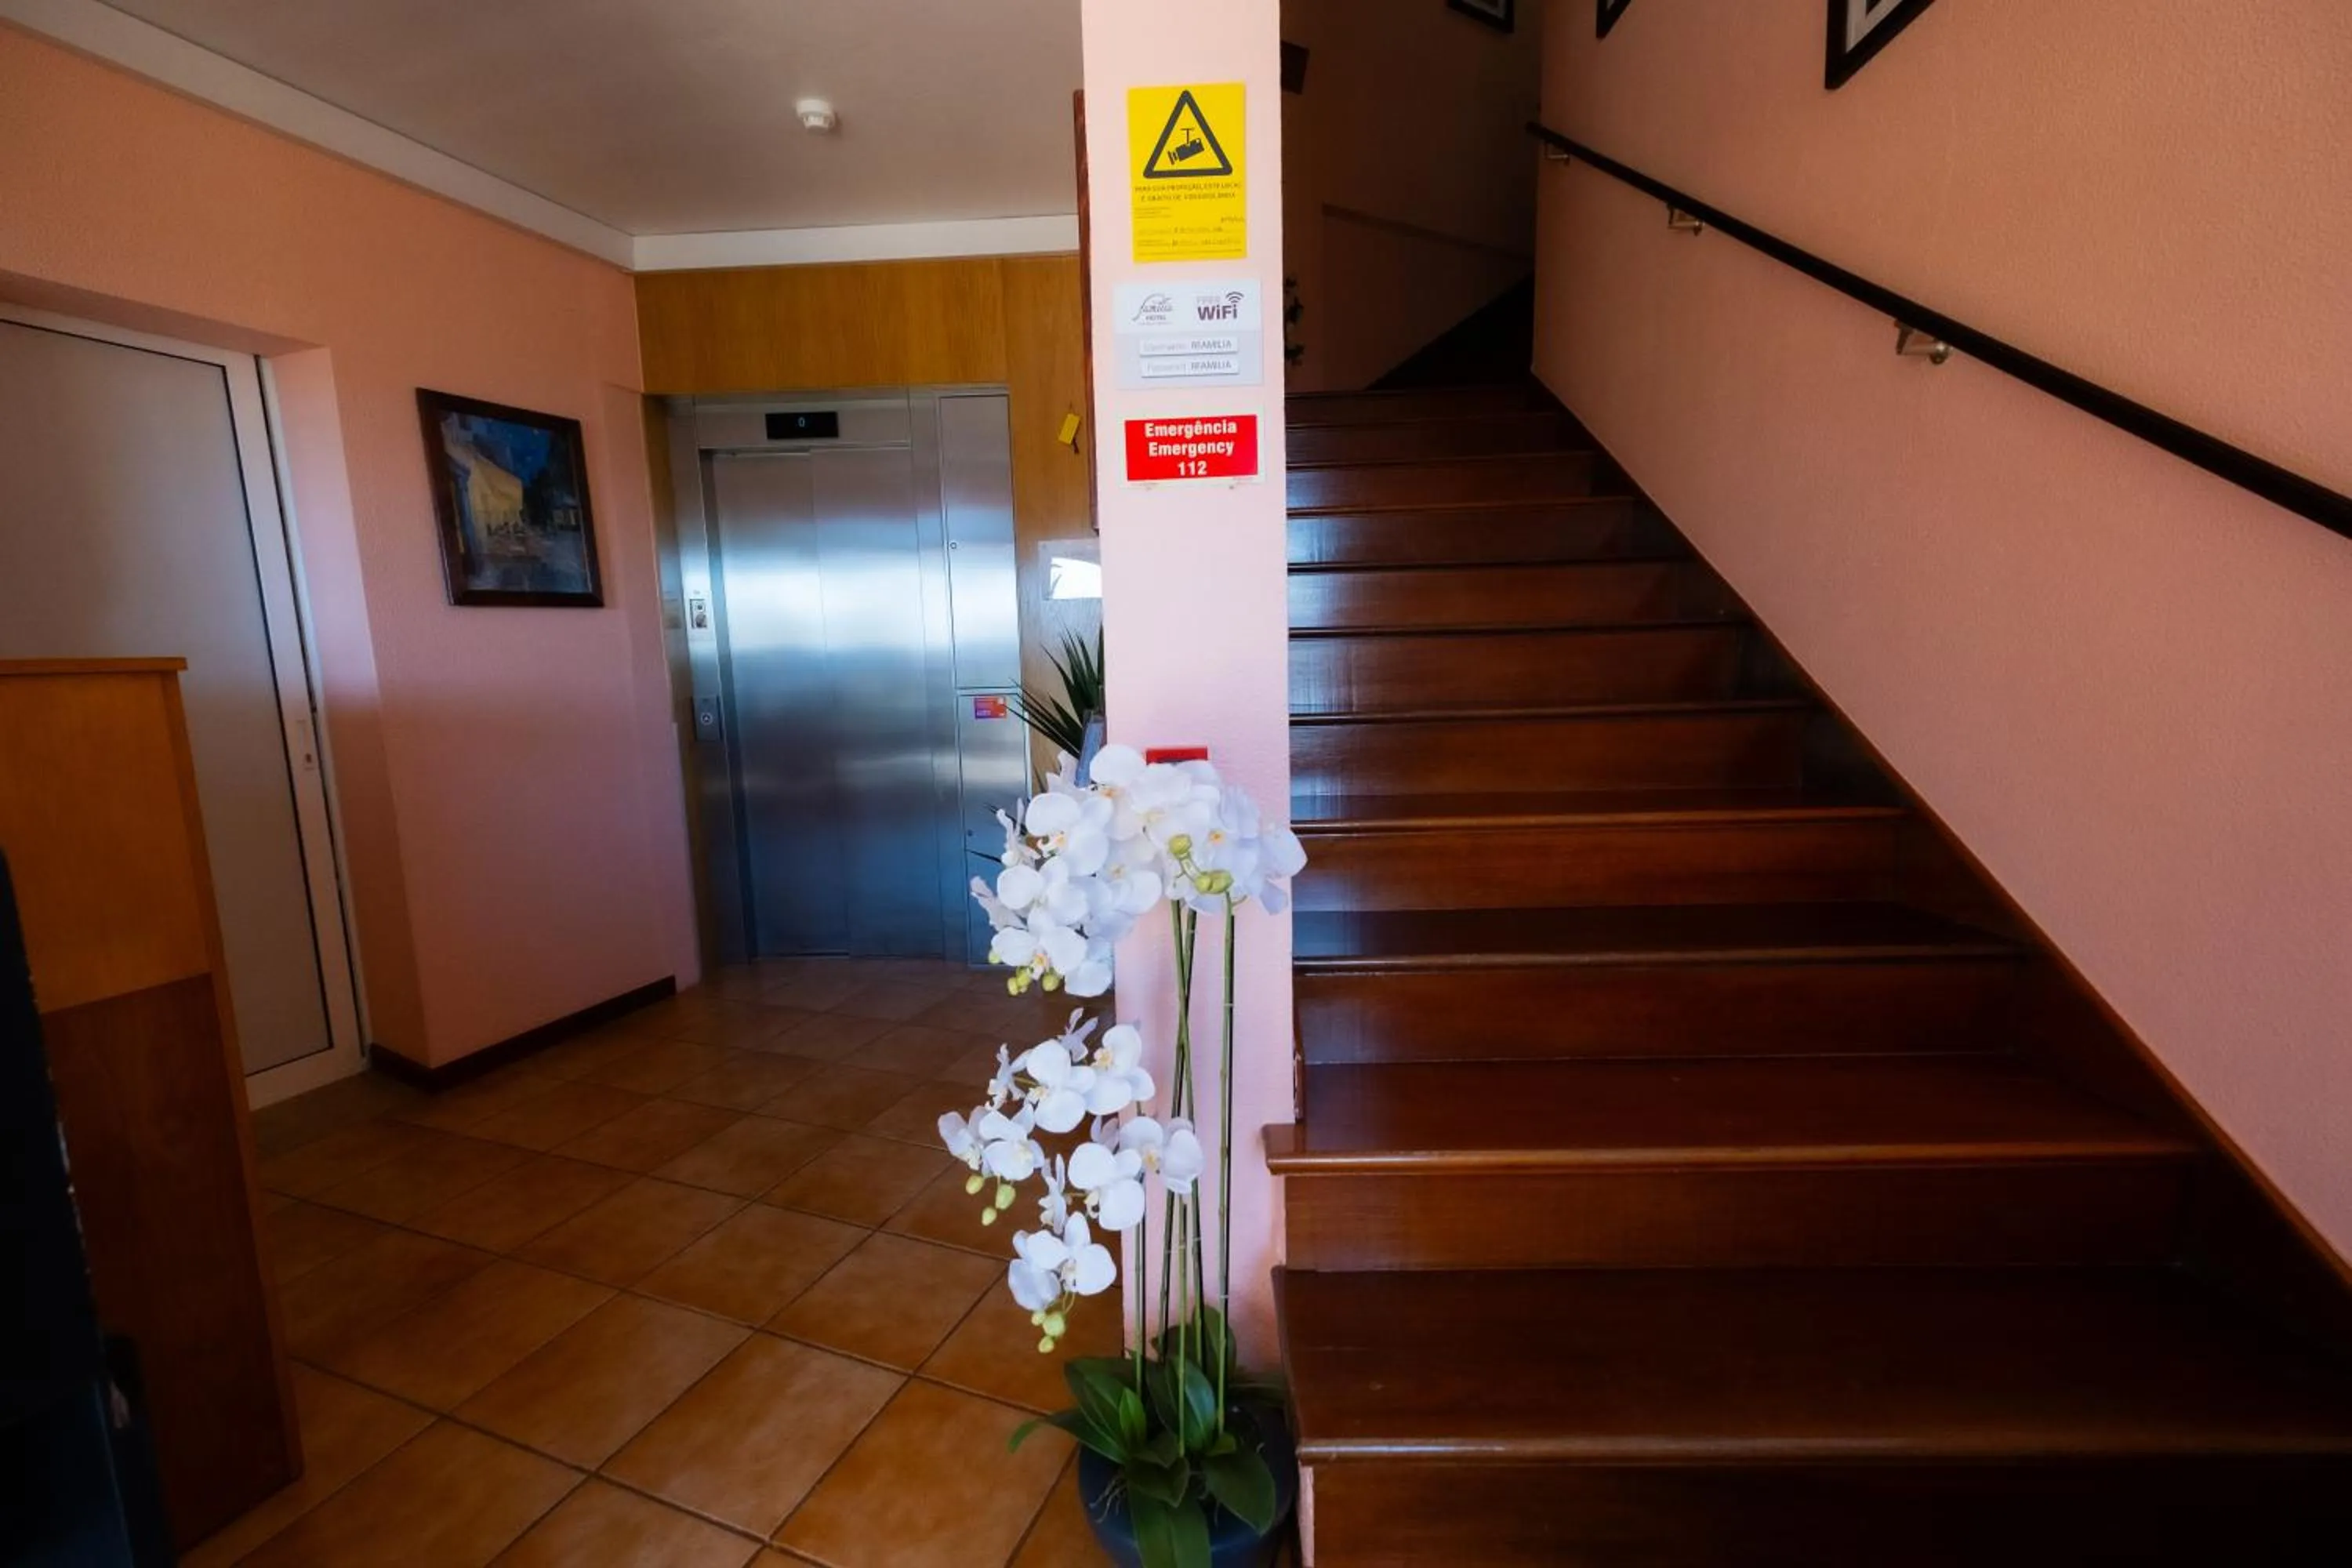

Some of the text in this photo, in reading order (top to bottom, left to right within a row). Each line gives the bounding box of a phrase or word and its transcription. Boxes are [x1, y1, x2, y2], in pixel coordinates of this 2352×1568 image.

[1197, 303, 1238, 321] WiFi
[1144, 419, 1237, 439] Emergência
[1148, 441, 1235, 458] Emergency
[1178, 460, 1208, 476] 112
